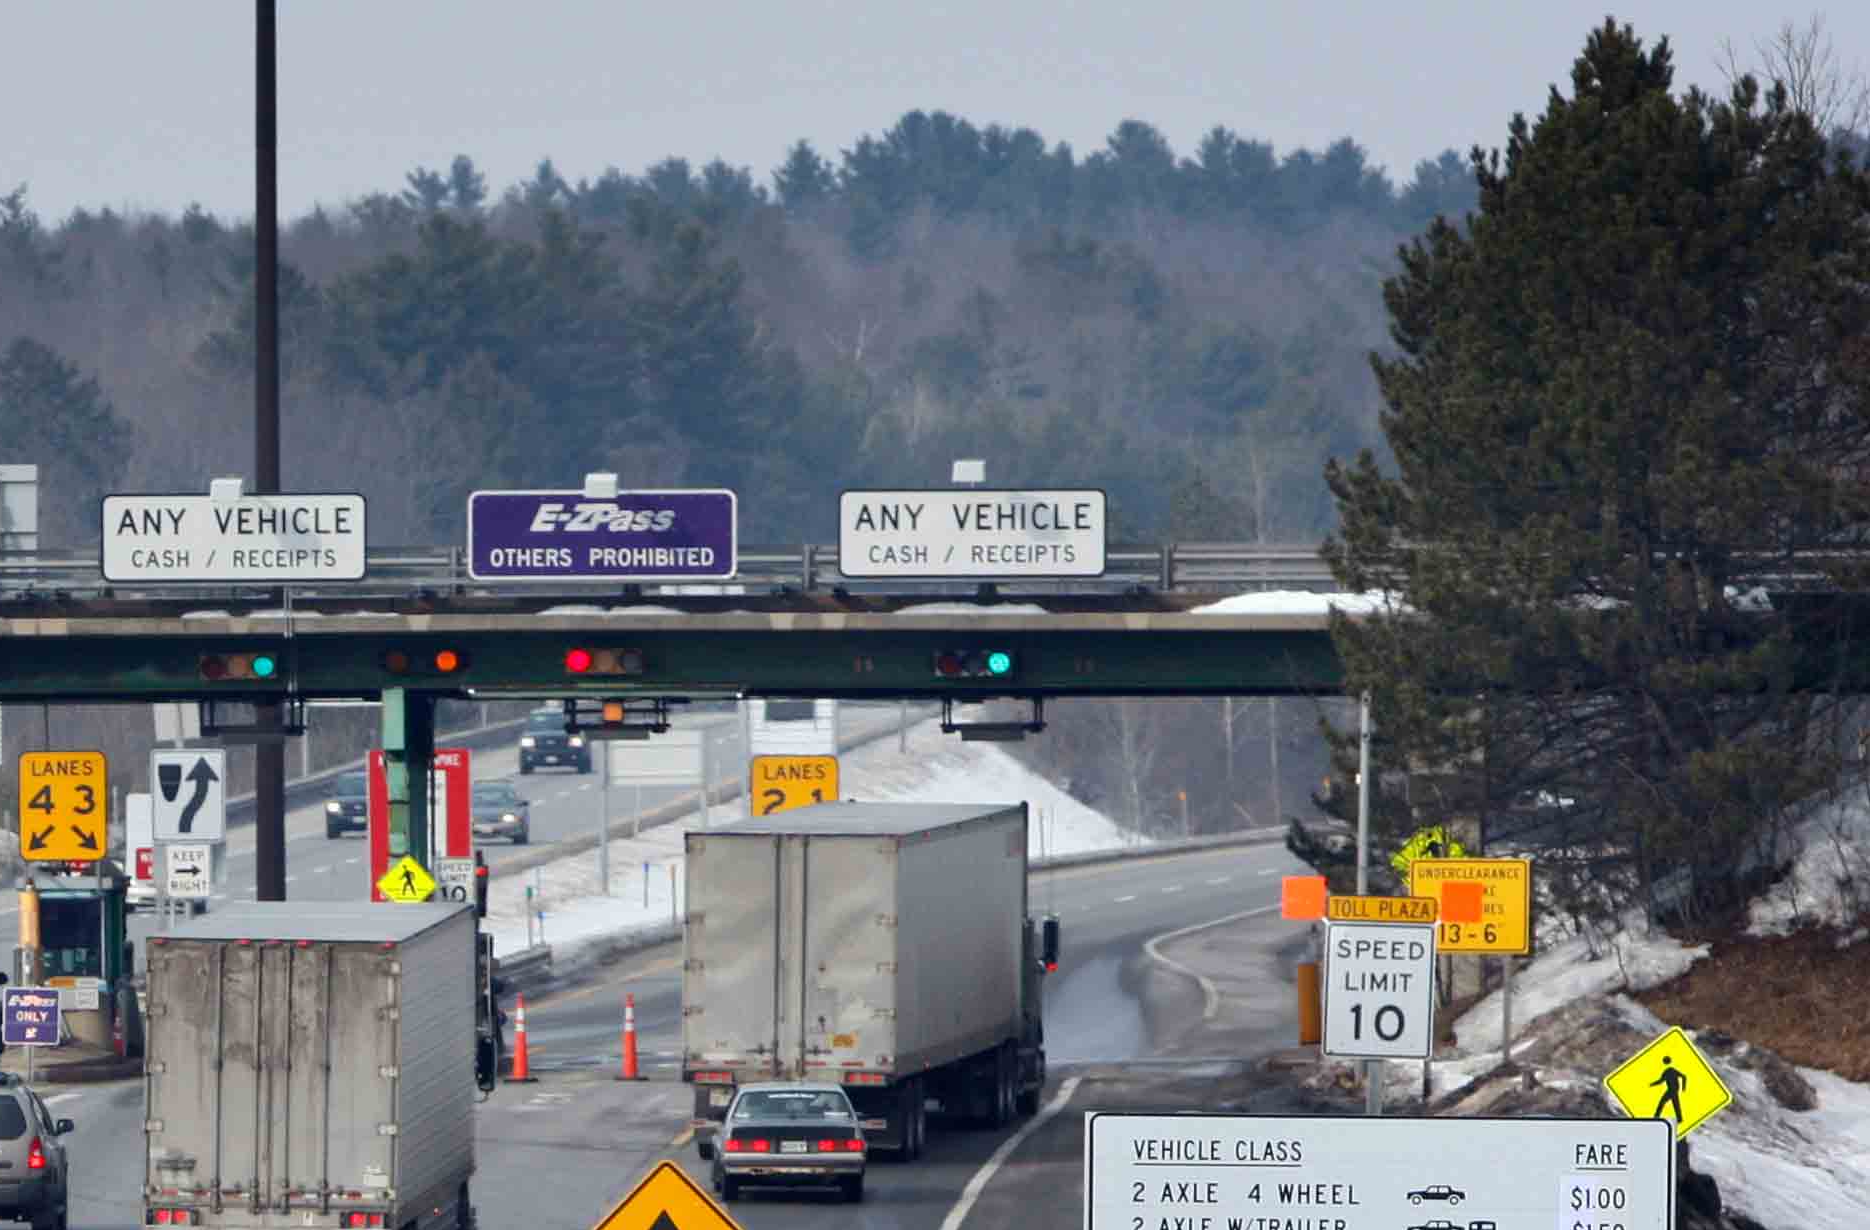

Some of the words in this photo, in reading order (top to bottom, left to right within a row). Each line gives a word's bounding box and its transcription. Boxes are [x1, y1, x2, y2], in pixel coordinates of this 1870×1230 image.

[118, 508, 185, 535] ANY
[214, 508, 352, 535] VEHICLE
[530, 503, 675, 532] E-ZPass
[855, 504, 923, 531] ANY
[953, 503, 1091, 531] VEHICLE
[132, 549, 191, 569] CASH
[206, 549, 216, 568] /
[233, 549, 336, 568] RECEIPTS
[490, 548, 572, 566] OTHERS
[589, 548, 714, 566] PROHIBITED
[869, 544, 928, 564] CASH
[944, 544, 954, 564] /
[972, 544, 1076, 563] RECEIPTS
[30, 759, 94, 777] LANES
[763, 764, 826, 780] LANES
[28, 787, 55, 815] 4
[73, 786, 96, 814] 3
[1332, 900, 1370, 917] TOLL
[1379, 901, 1431, 918] PLAZA
[1484, 923, 1497, 944] 6
[1337, 940, 1425, 960] SPEED
[1345, 974, 1412, 992] LIMIT
[16, 1011, 48, 1022] ONLY
[1350, 1004, 1405, 1041] 10
[1133, 1140, 1221, 1162] VEHICLE
[1235, 1141, 1302, 1162] CLASS
[1575, 1144, 1627, 1165] FARE
[1133, 1183, 1145, 1204] 2
[1161, 1183, 1218, 1204] AXLE
[1248, 1184, 1262, 1204] 4
[1279, 1184, 1360, 1205] WHEEL
[1570, 1187, 1626, 1210] $1.00
